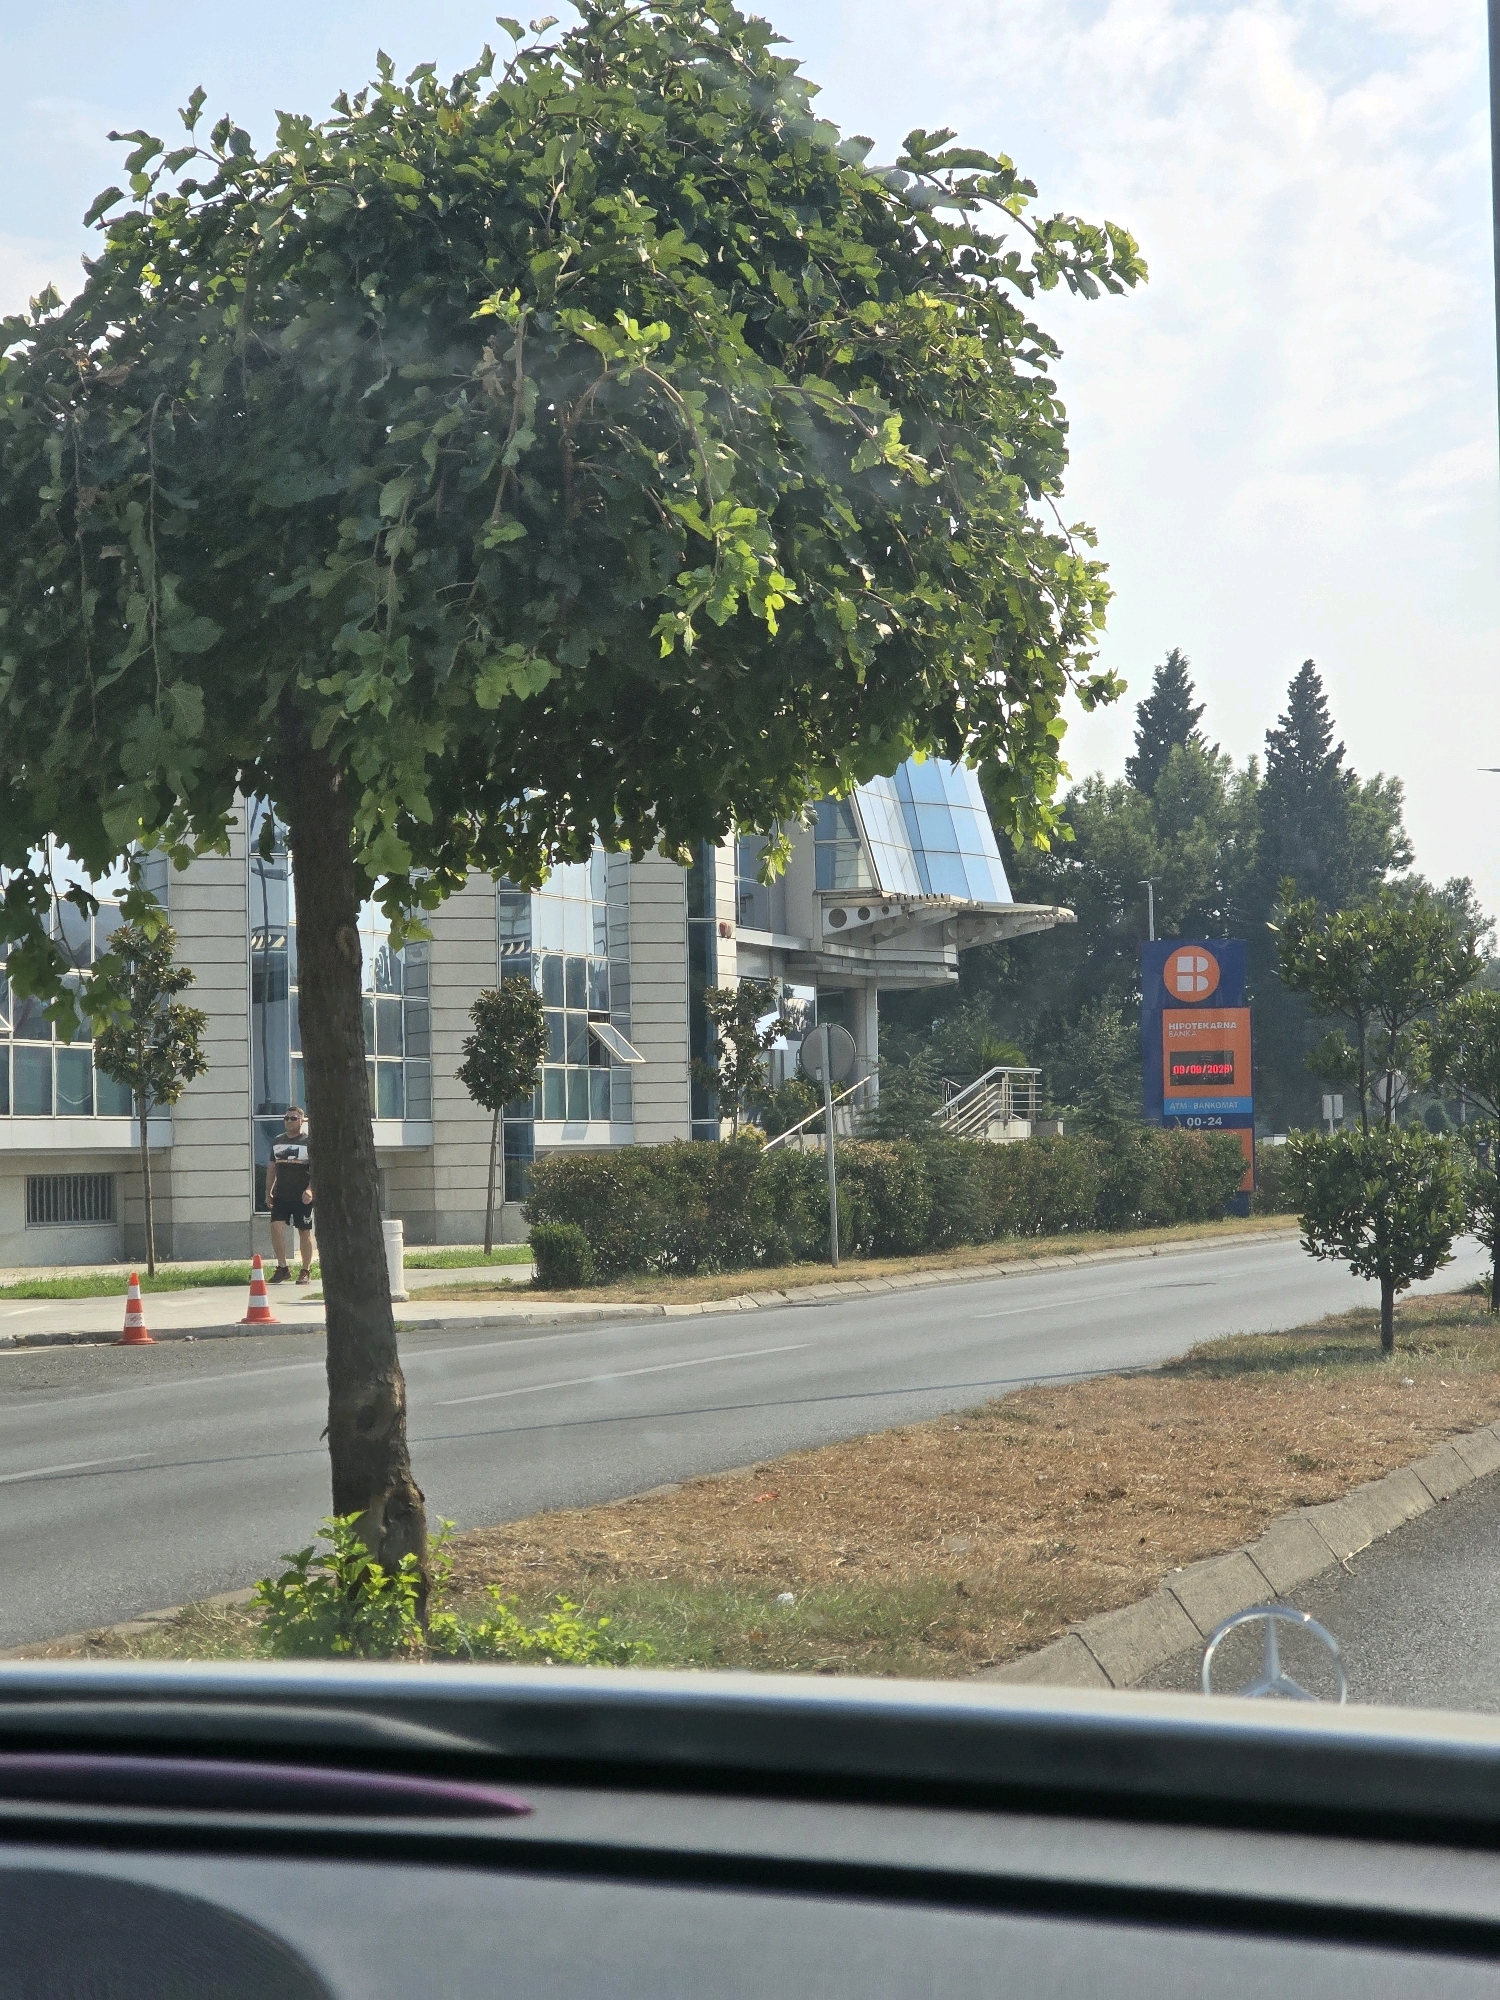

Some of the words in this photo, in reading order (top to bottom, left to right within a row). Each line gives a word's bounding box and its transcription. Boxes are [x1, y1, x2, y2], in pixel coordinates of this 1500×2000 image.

[1168, 1021, 1237, 1030] HIPOTEKARNA
[1168, 1030, 1197, 1038] BANKA
[1170, 1102, 1188, 1110] ATM
[1193, 1101, 1239, 1110] BANKOMAT
[1186, 1117, 1223, 1126] 00-24
